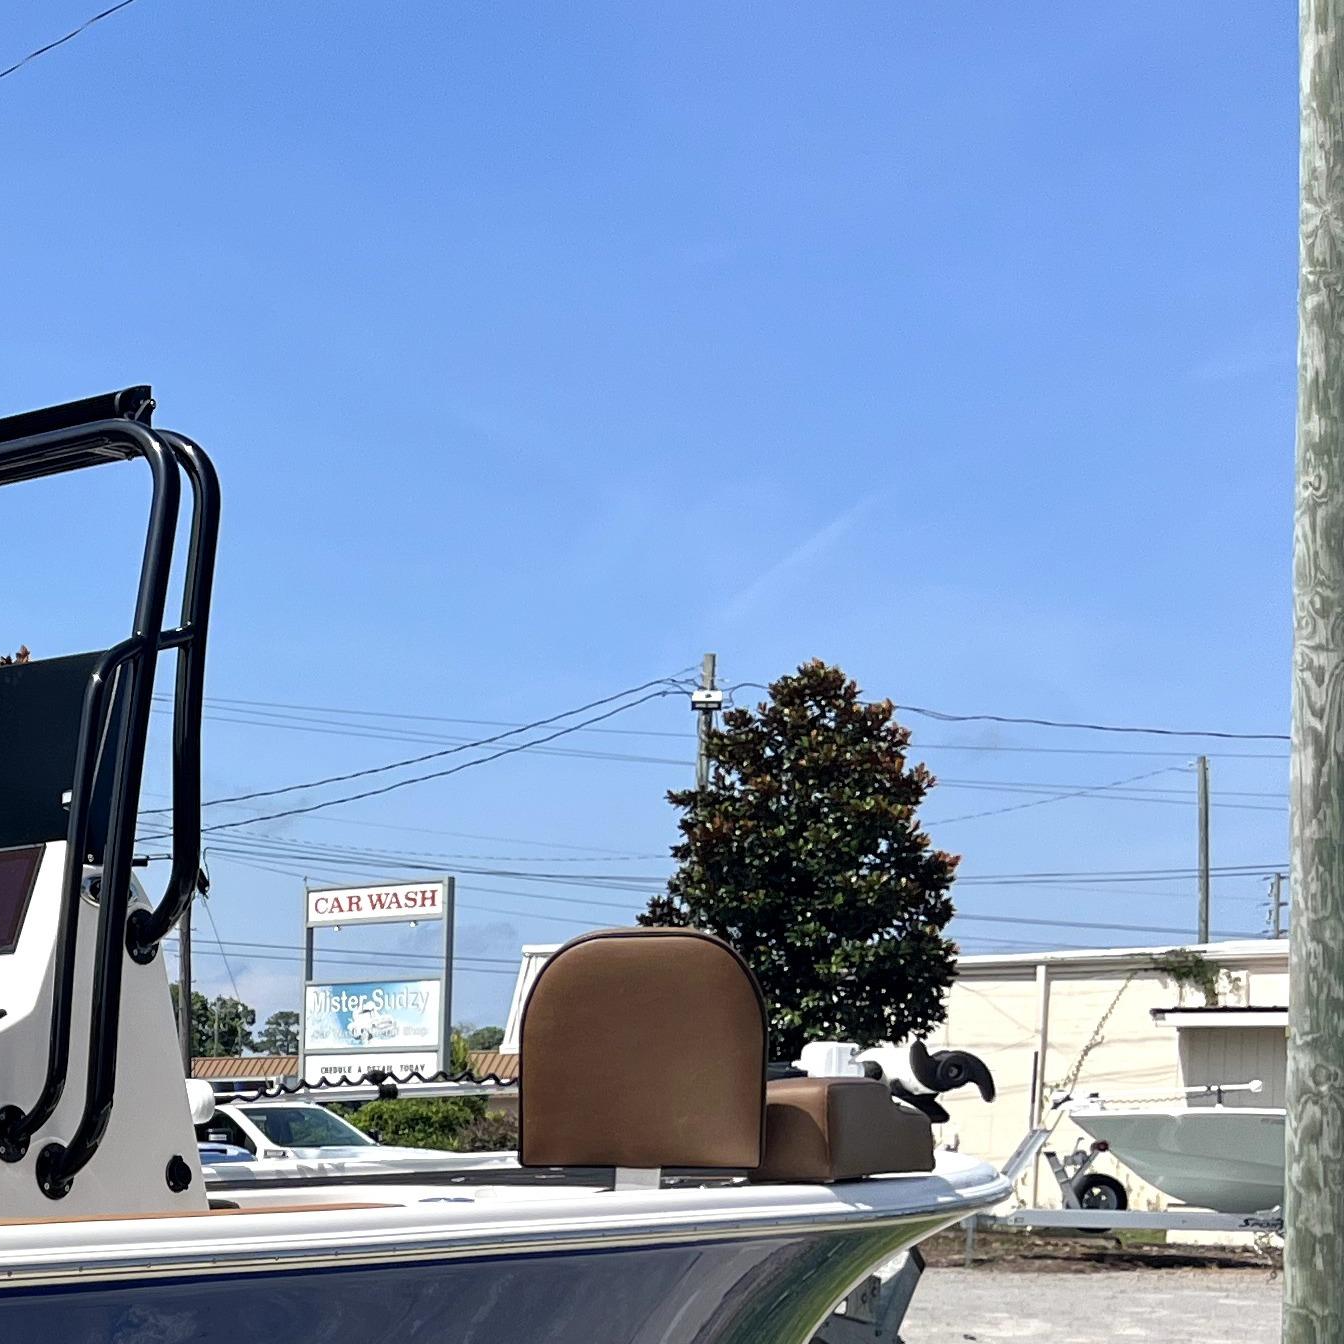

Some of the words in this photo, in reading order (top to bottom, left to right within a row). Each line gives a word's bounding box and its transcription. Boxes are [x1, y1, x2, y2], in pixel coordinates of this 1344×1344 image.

[314, 895, 363, 914] CAR
[368, 890, 438, 911] WASH
[312, 989, 368, 1013] Mister
[372, 986, 430, 1015] Sudzy
